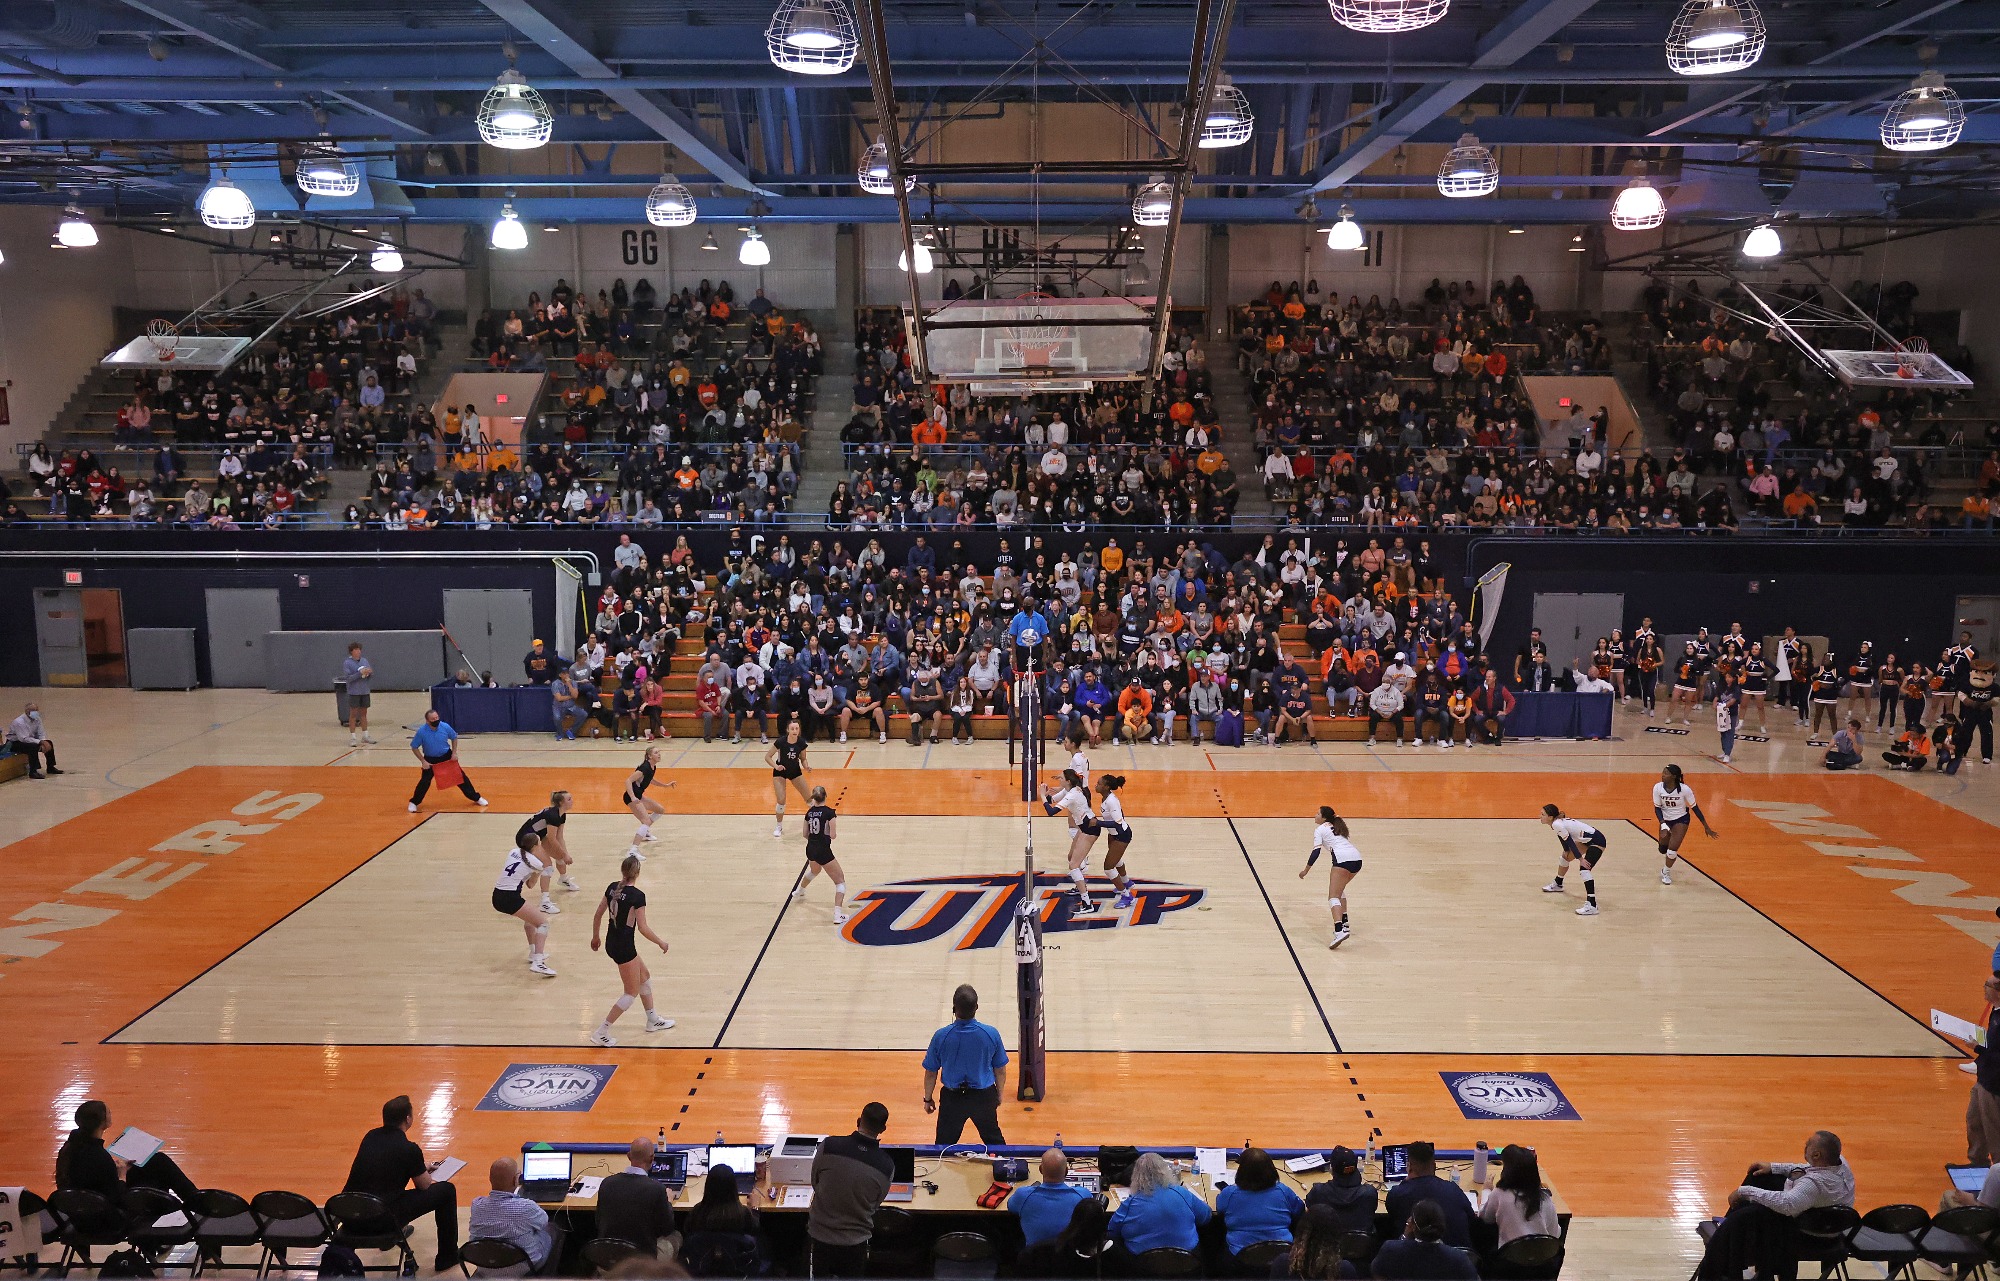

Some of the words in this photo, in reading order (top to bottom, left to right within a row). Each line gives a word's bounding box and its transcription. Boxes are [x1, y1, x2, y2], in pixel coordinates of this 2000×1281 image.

[621, 229, 658, 265] GG
[997, 555, 1013, 563] UTEP
[1649, 727, 1687, 735] UTEP
[786, 751, 797, 760] 15
[808, 817, 820, 835] 19
[504, 862, 521, 877] 4
[838, 871, 1207, 952] UTEP
[510, 1079, 590, 1089] NIVC
[1465, 1086, 1548, 1098] NIVC
